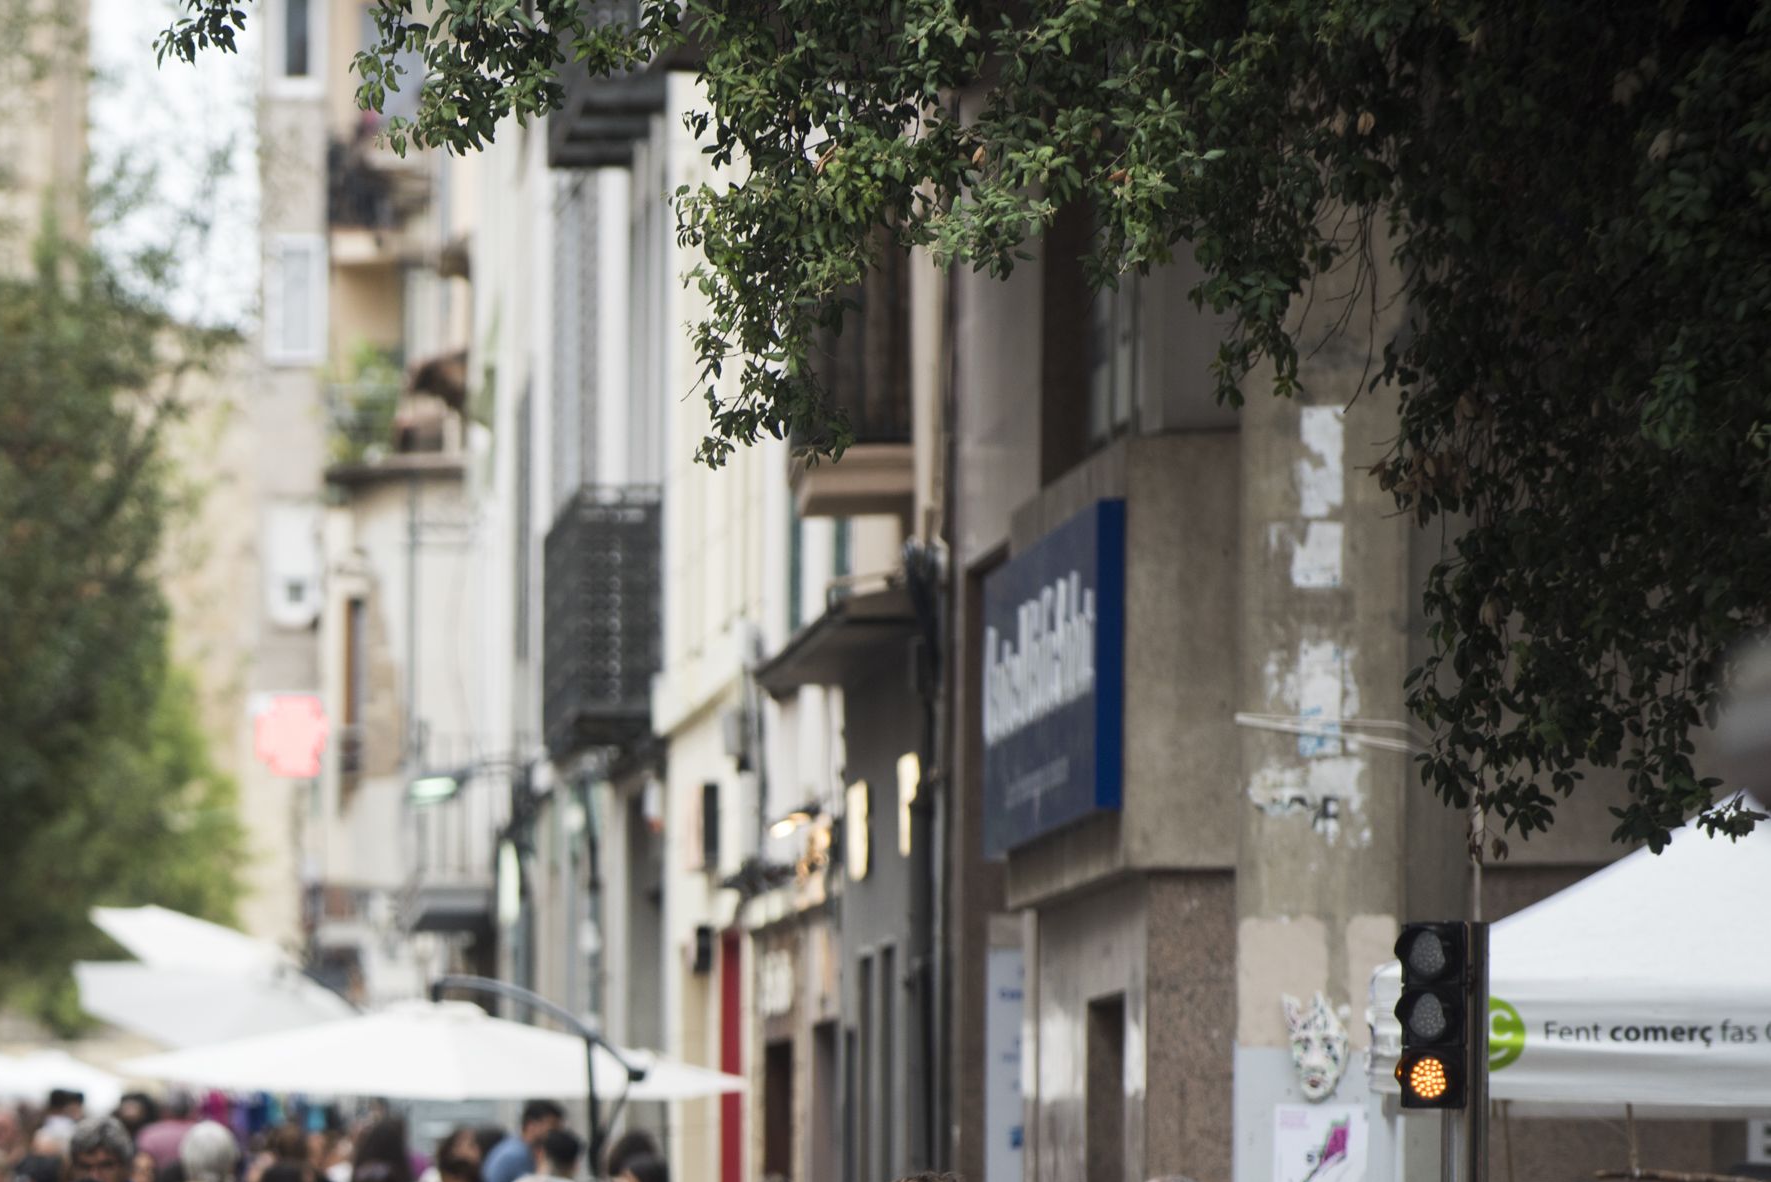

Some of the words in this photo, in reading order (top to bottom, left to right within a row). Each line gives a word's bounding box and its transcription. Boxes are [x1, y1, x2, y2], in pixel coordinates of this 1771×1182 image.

[1543, 1020, 1602, 1042] Fent
[1610, 1023, 1713, 1049] comerç
[1720, 1018, 1759, 1044] fas
